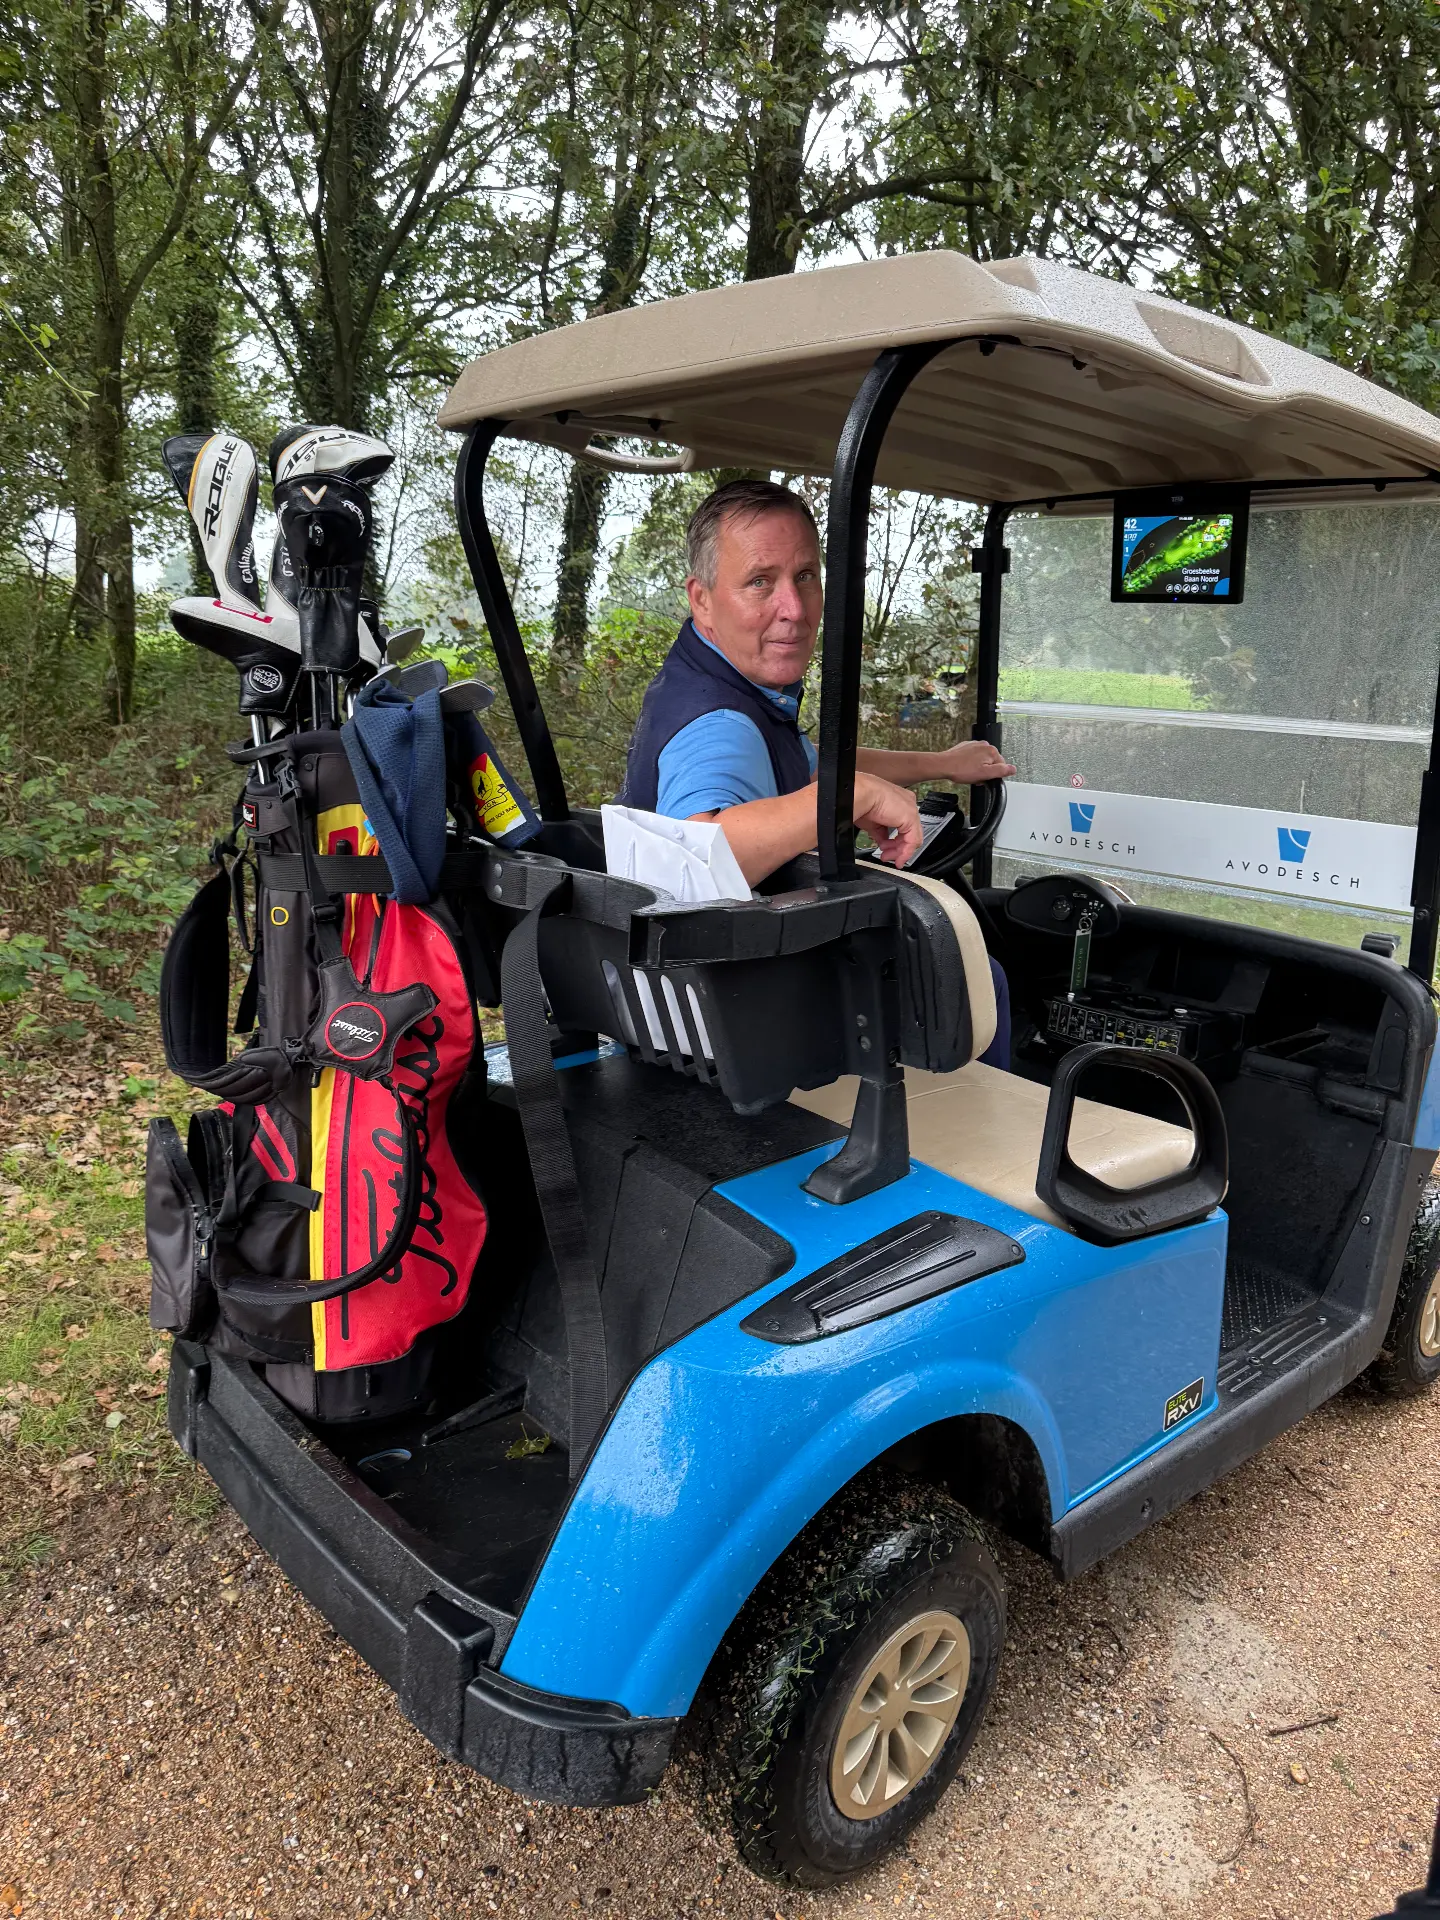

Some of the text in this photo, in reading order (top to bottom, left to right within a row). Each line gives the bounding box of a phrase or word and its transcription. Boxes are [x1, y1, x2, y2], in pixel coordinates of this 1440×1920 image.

[281, 433, 372, 480] OGUE
[304, 448, 316, 462] ST
[226, 471, 234, 482] ST
[204, 441, 237, 541] ROGUE
[1124, 518, 1137, 529] 42
[238, 540, 254, 584] Callawa
[1181, 567, 1220, 575] Groesbeekse
[1200, 575, 1219, 583] Noord
[1029, 831, 1136, 855] AVODESCH
[1225, 860, 1360, 888] AVODESCH
[331, 1019, 380, 1043] Titleist
[1167, 1392, 1200, 1426] RXV
[1168, 1391, 1187, 1411] ELITE
